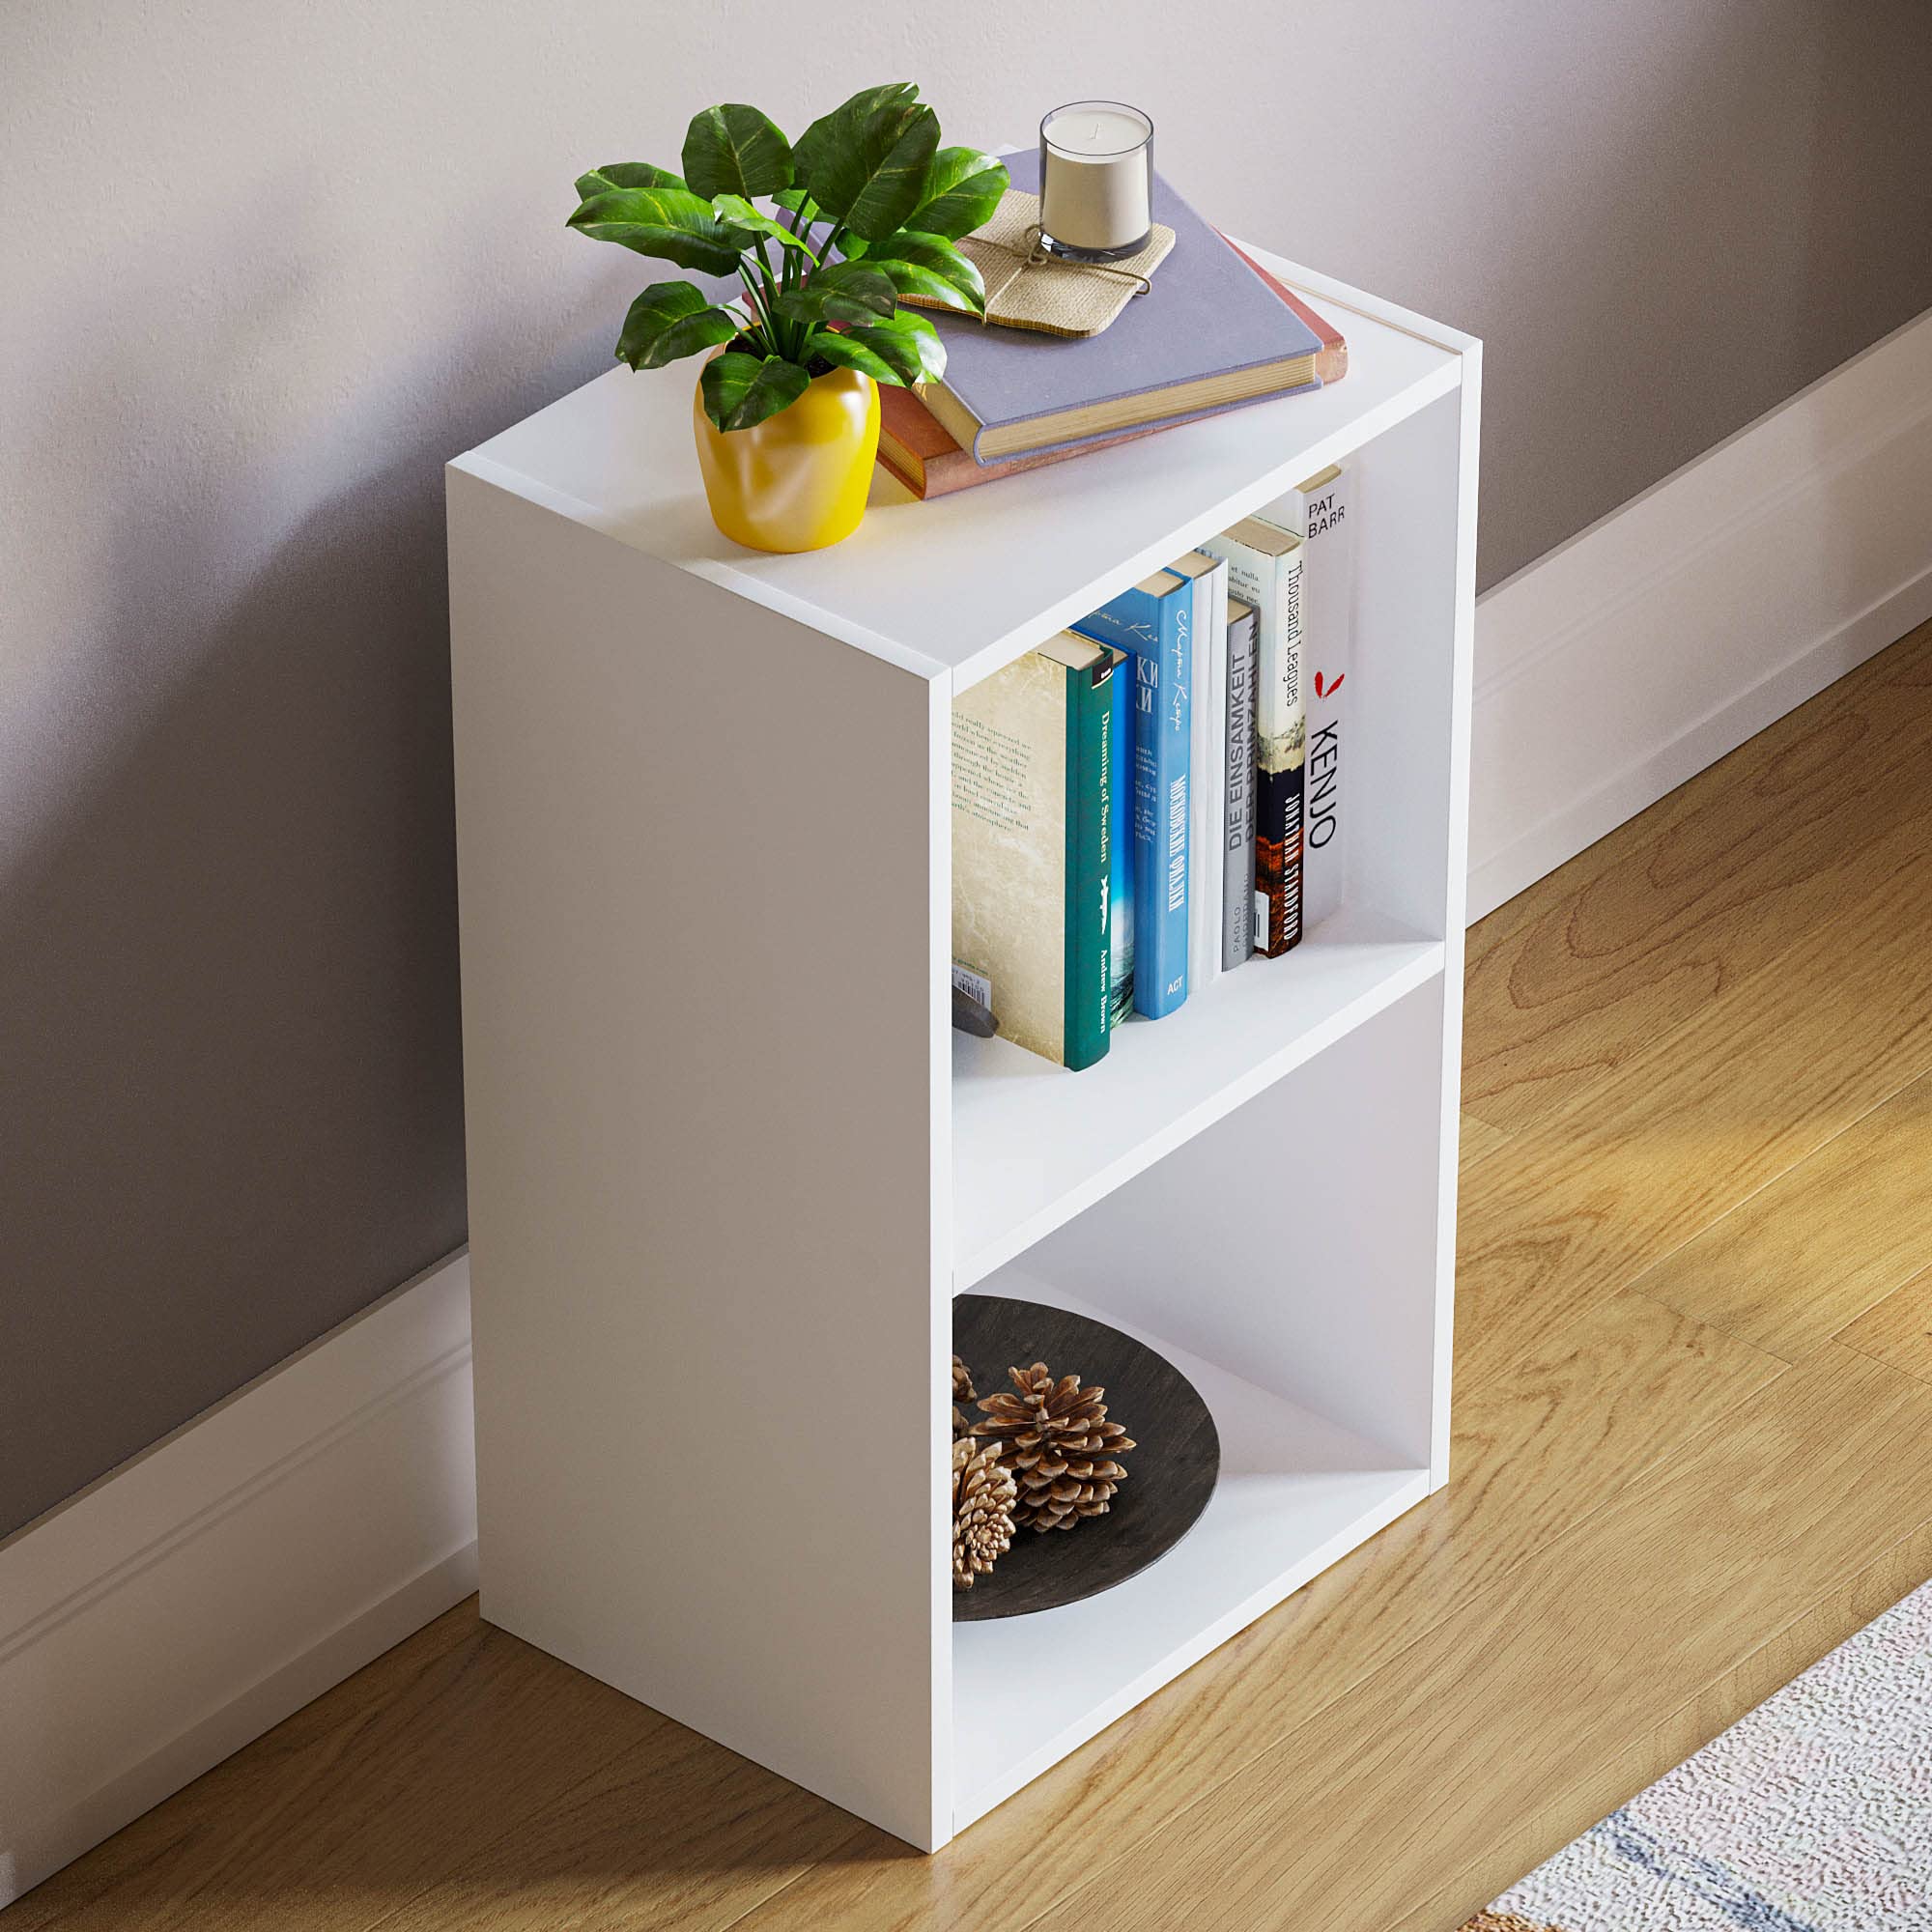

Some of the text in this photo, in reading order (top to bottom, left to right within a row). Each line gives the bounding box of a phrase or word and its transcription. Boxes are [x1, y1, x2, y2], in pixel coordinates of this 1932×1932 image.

[1309, 493, 1335, 519] PAT
[1309, 505, 1345, 539] BARR
[1283, 560, 1303, 707] Thousand Leagues
[1099, 711, 1110, 863] Dreaming of Sweden
[1229, 654, 1245, 851] DIE EINSAMKEIT
[1244, 789, 1256, 842] DER
[1309, 719, 1339, 849] KENJO
[1169, 773, 1186, 912] МОСКОВСКИЕ ФИАЛКИ
[1283, 792, 1300, 941] JONATHAN STANDFORD
